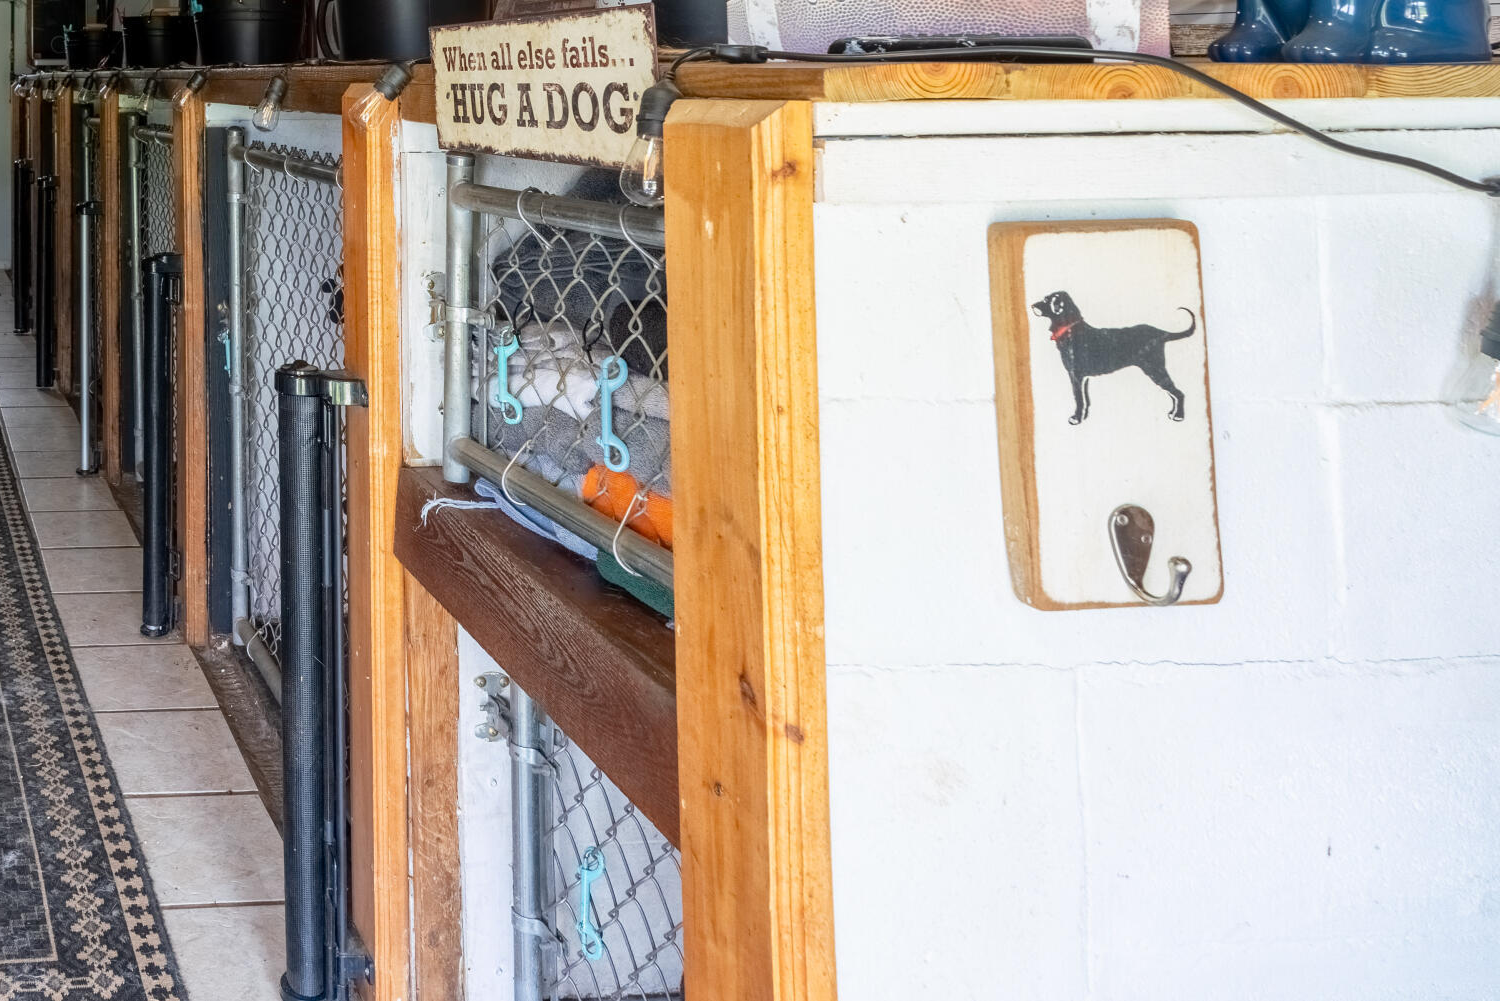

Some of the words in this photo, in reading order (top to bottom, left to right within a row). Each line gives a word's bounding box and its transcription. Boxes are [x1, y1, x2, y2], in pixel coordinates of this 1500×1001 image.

[442, 45, 486, 72] When
[490, 42, 513, 71] all
[517, 41, 556, 70] else
[561, 36, 635, 69] fails...
[450, 82, 508, 126] HUG
[516, 82, 539, 128] A
[543, 81, 634, 134] DOG
